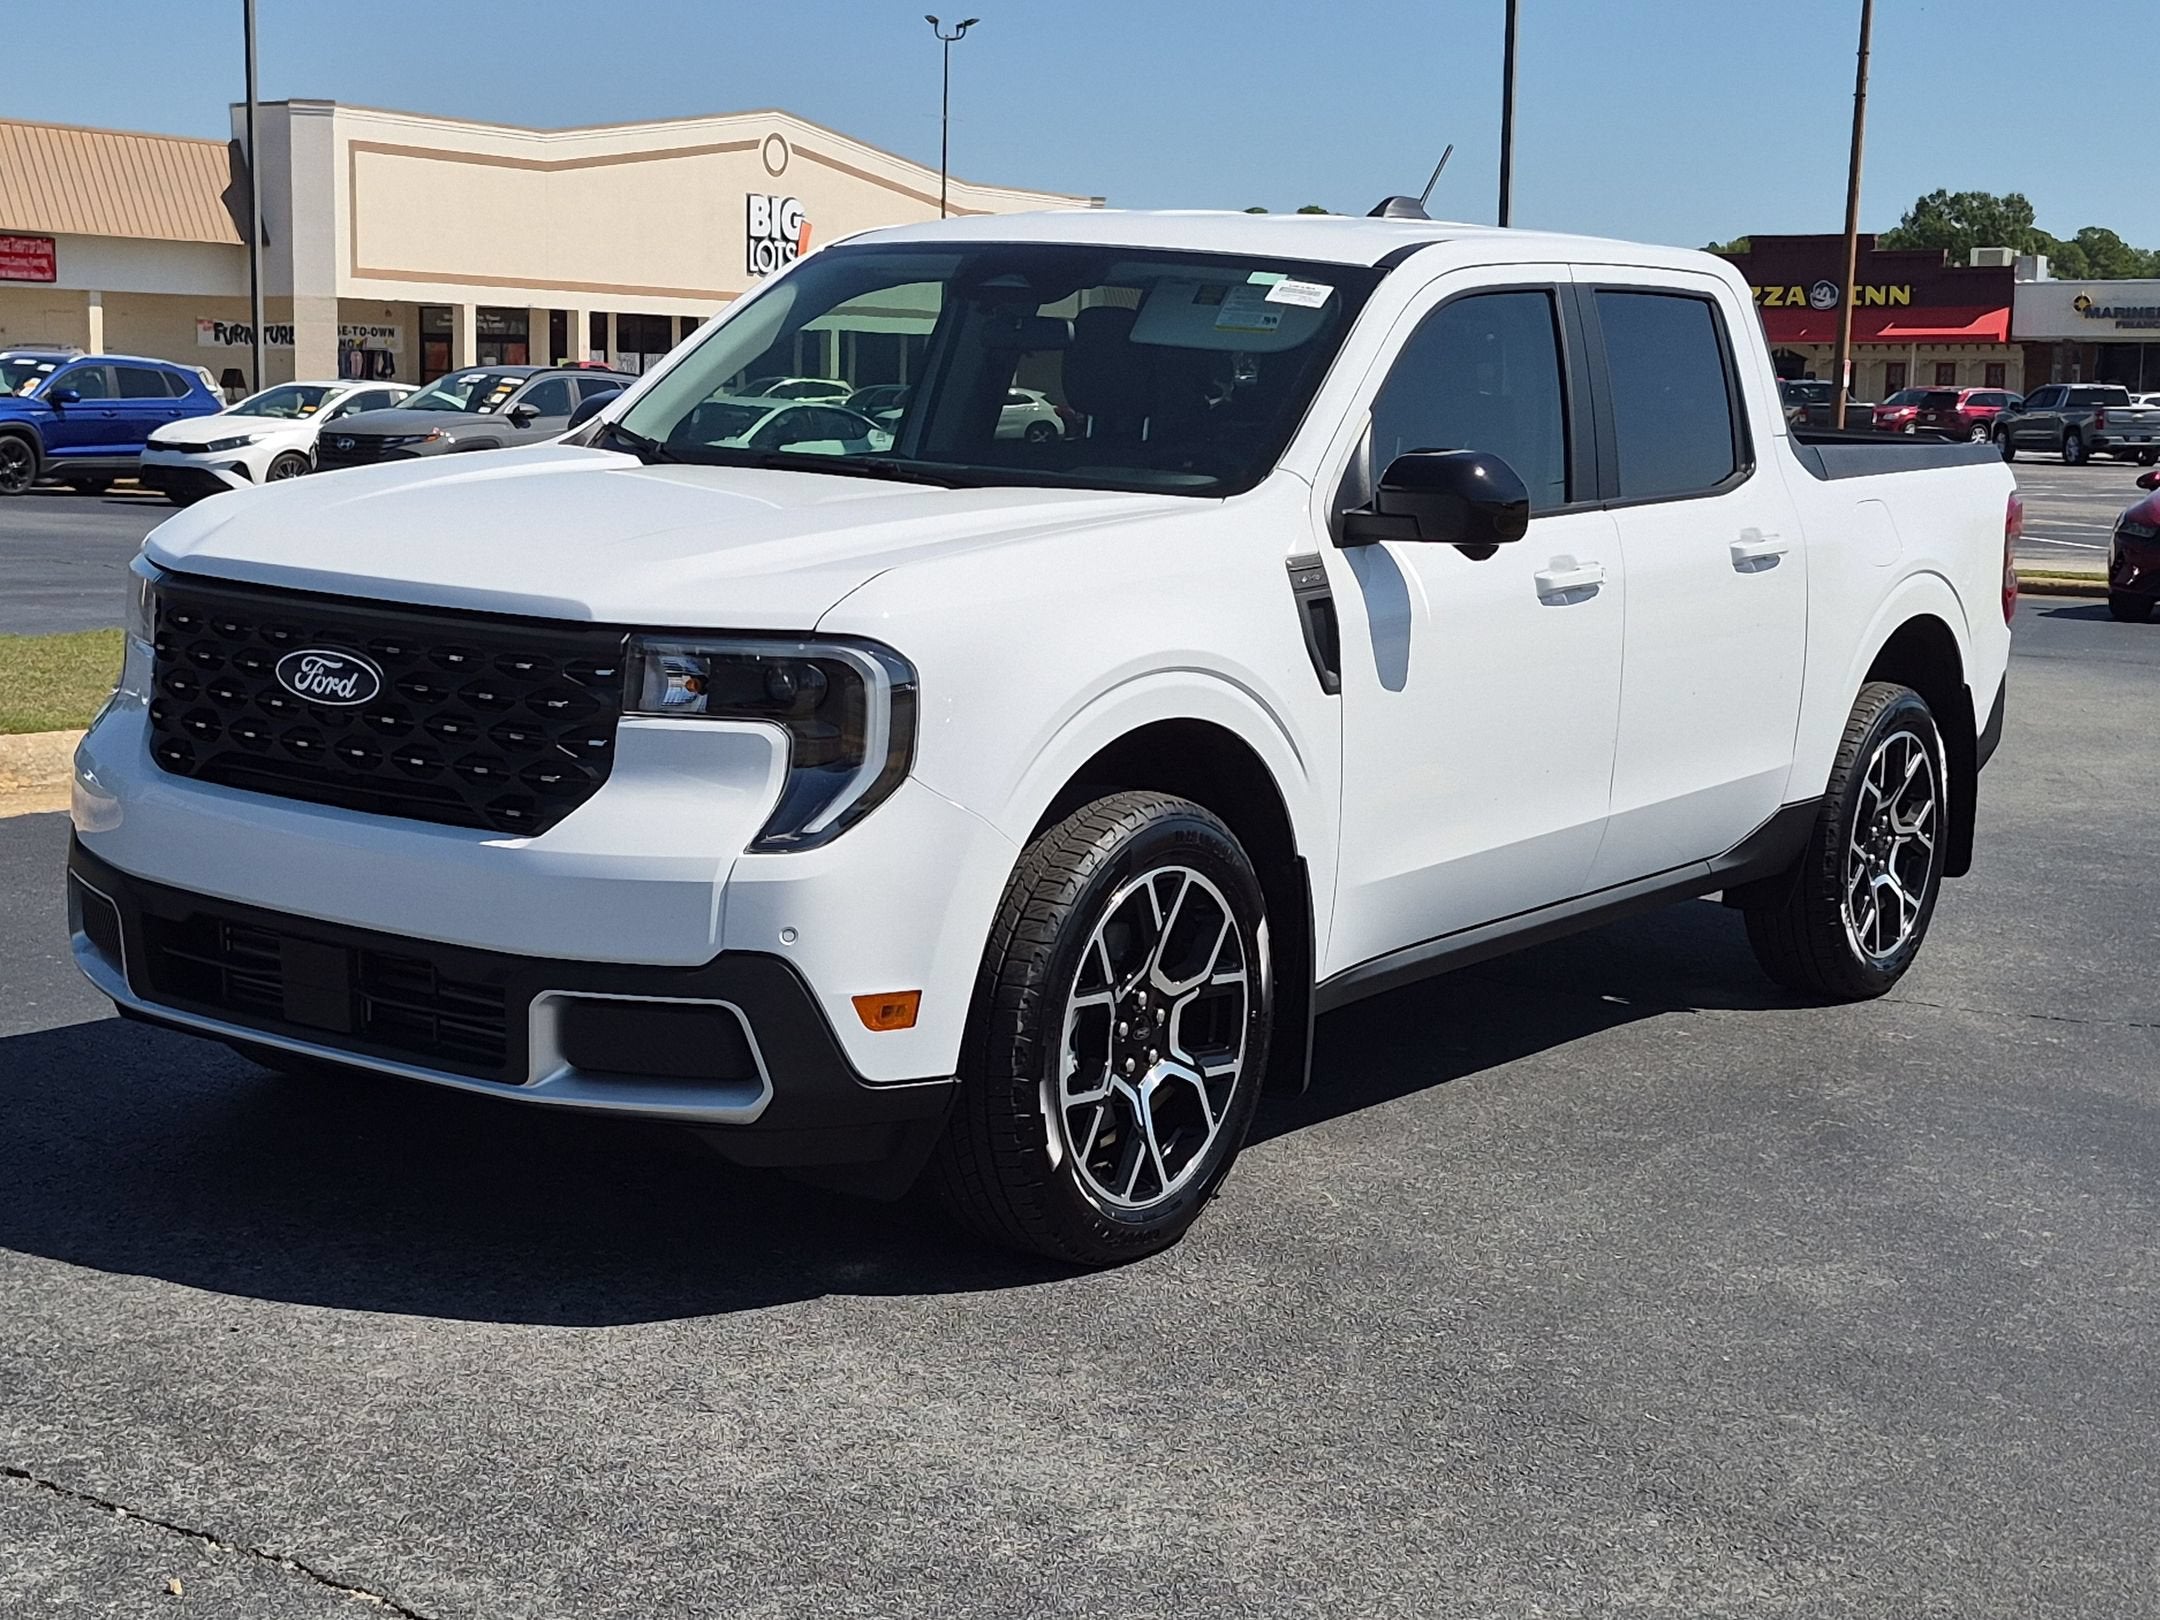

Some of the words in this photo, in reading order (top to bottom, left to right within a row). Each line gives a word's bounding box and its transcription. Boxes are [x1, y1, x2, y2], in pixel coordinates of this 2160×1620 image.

[746, 193, 805, 241] BIG
[746, 238, 800, 275] LOTS
[338, 325, 394, 337] E-TO-OWN
[2085, 307, 2160, 319] MARINE
[294, 656, 359, 698] Ford
